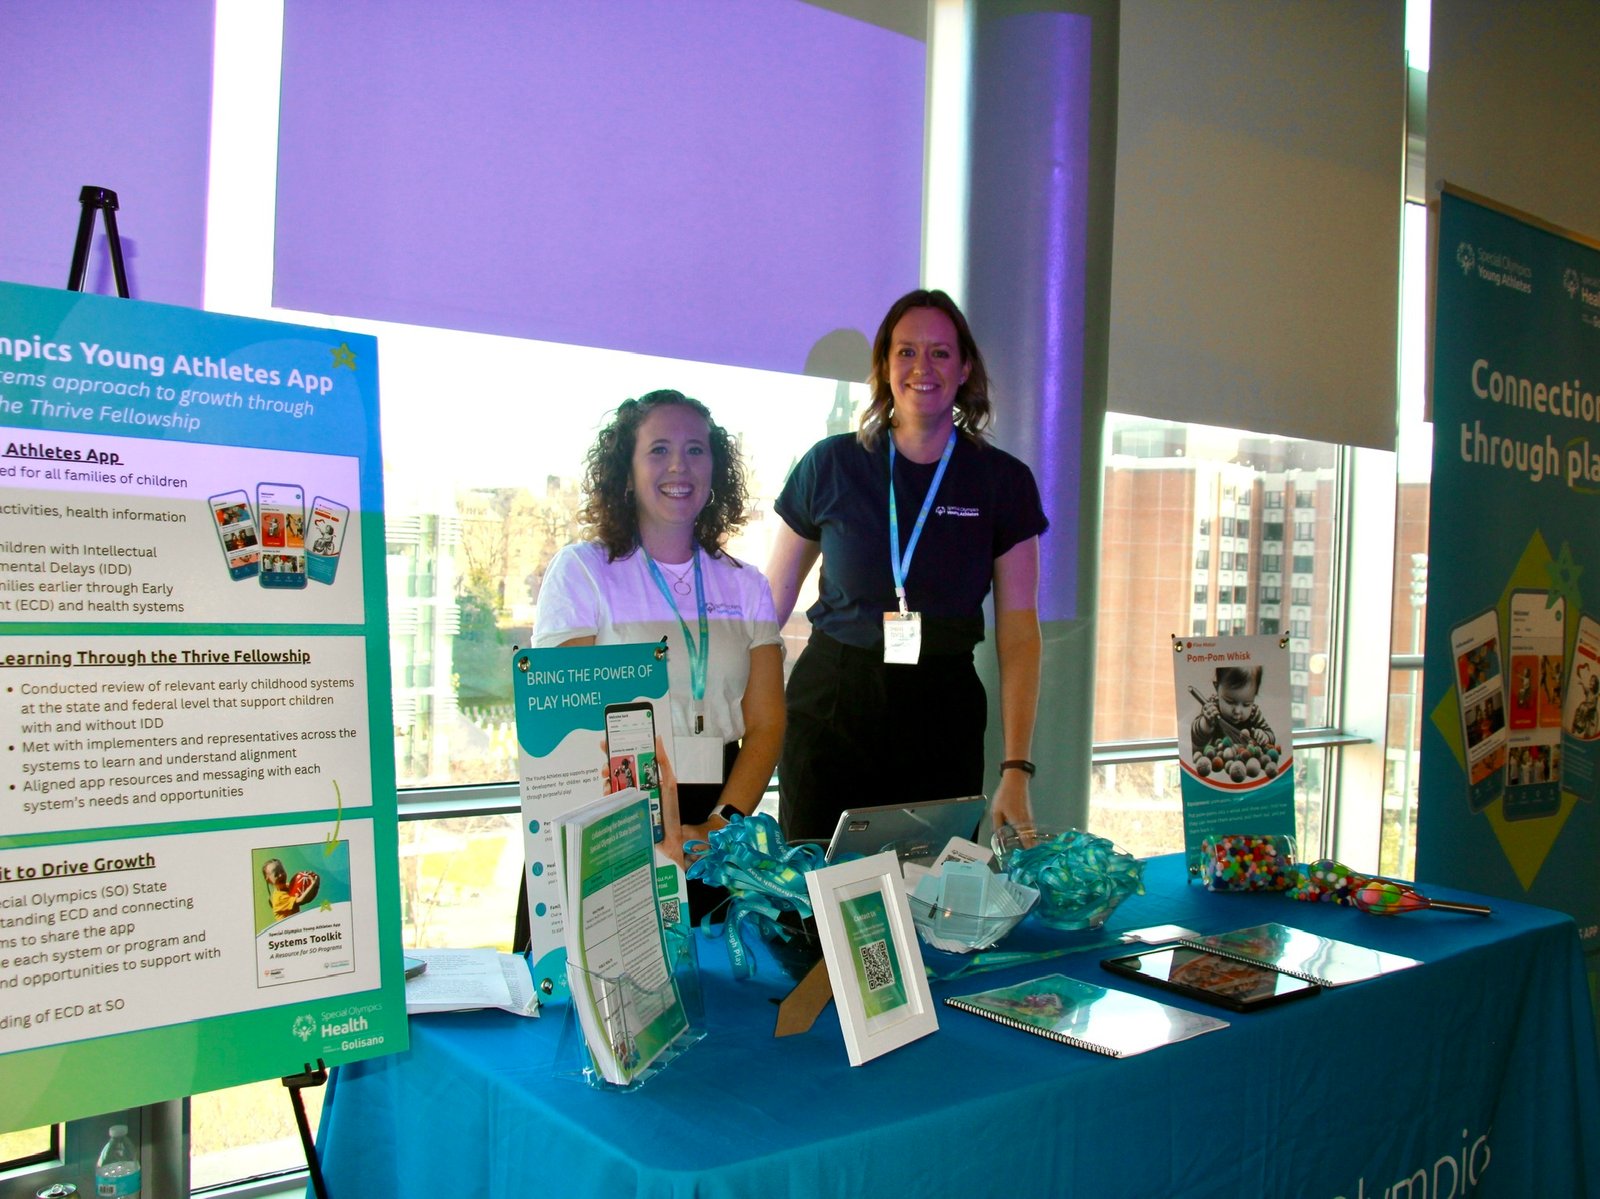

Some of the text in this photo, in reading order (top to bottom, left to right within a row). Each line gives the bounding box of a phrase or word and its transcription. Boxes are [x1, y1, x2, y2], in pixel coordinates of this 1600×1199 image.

[1478, 265, 1531, 293] Young Athletes
[80, 343, 165, 376] Young
[173, 354, 280, 387] Athletes
[287, 371, 334, 396] App
[52, 375, 150, 399] approach
[156, 385, 175, 400] to
[180, 389, 242, 408] growth
[248, 394, 314, 417] through
[1472, 358, 1600, 423] Connectio
[30, 399, 94, 421] Thrive
[100, 406, 200, 431] Fellowship
[6, 442, 119, 465] Athletes App
[1461, 420, 1559, 483] through
[21, 466, 38, 479] for
[45, 467, 61, 480] all
[65, 469, 115, 484] families
[120, 472, 134, 485] of
[136, 475, 188, 488] children
[0, 504, 186, 523] ctivities, health information
[50, 543, 79, 555] with
[83, 544, 157, 558] Intellectual
[50, 562, 95, 577] Delays
[99, 562, 132, 576] (IDD)
[39, 581, 81, 594] earlier
[86, 582, 138, 596] through
[142, 583, 173, 597] Early
[15, 598, 53, 613] (ECD)
[58, 600, 84, 612] and
[88, 600, 129, 612] health
[133, 602, 184, 615] systems
[77, 650, 146, 666] Through
[151, 651, 177, 664] the
[181, 650, 230, 663] Thrive
[234, 649, 310, 664] Fellowship
[1187, 652, 1250, 662] Pom-Pom Whisk
[527, 665, 653, 685] BRING THE POWER OF
[21, 677, 354, 695] Conducted review of relevant early childhood systems
[21, 695, 334, 714] at the state and federal level that support children
[528, 692, 601, 711] PLAY HOME!
[22, 728, 356, 753] Met with implementers and representatives across the
[543, 790, 562, 798] purposeful
[16, 865, 36, 879] to
[43, 860, 89, 877] Drive
[94, 853, 155, 873] Growth
[0, 881, 167, 909] cial Olympics (SO) State
[60, 907, 89, 921] ECD
[93, 904, 117, 918] and
[122, 897, 194, 916] connecting
[269, 932, 342, 950] Systems Toolkit
[275, 951, 299, 959] Resource
[318, 944, 342, 952] Programs
[23, 965, 119, 986] opportunities
[123, 956, 136, 970] to
[140, 954, 190, 971] support
[195, 946, 220, 960] with
[35, 1009, 49, 1023] of
[55, 1006, 84, 1019] ECD
[89, 1002, 102, 1014] at
[106, 999, 125, 1011] SO
[322, 1003, 382, 1021] Special Olympics
[322, 1016, 368, 1038] Health
[341, 1036, 384, 1050] Golisano
